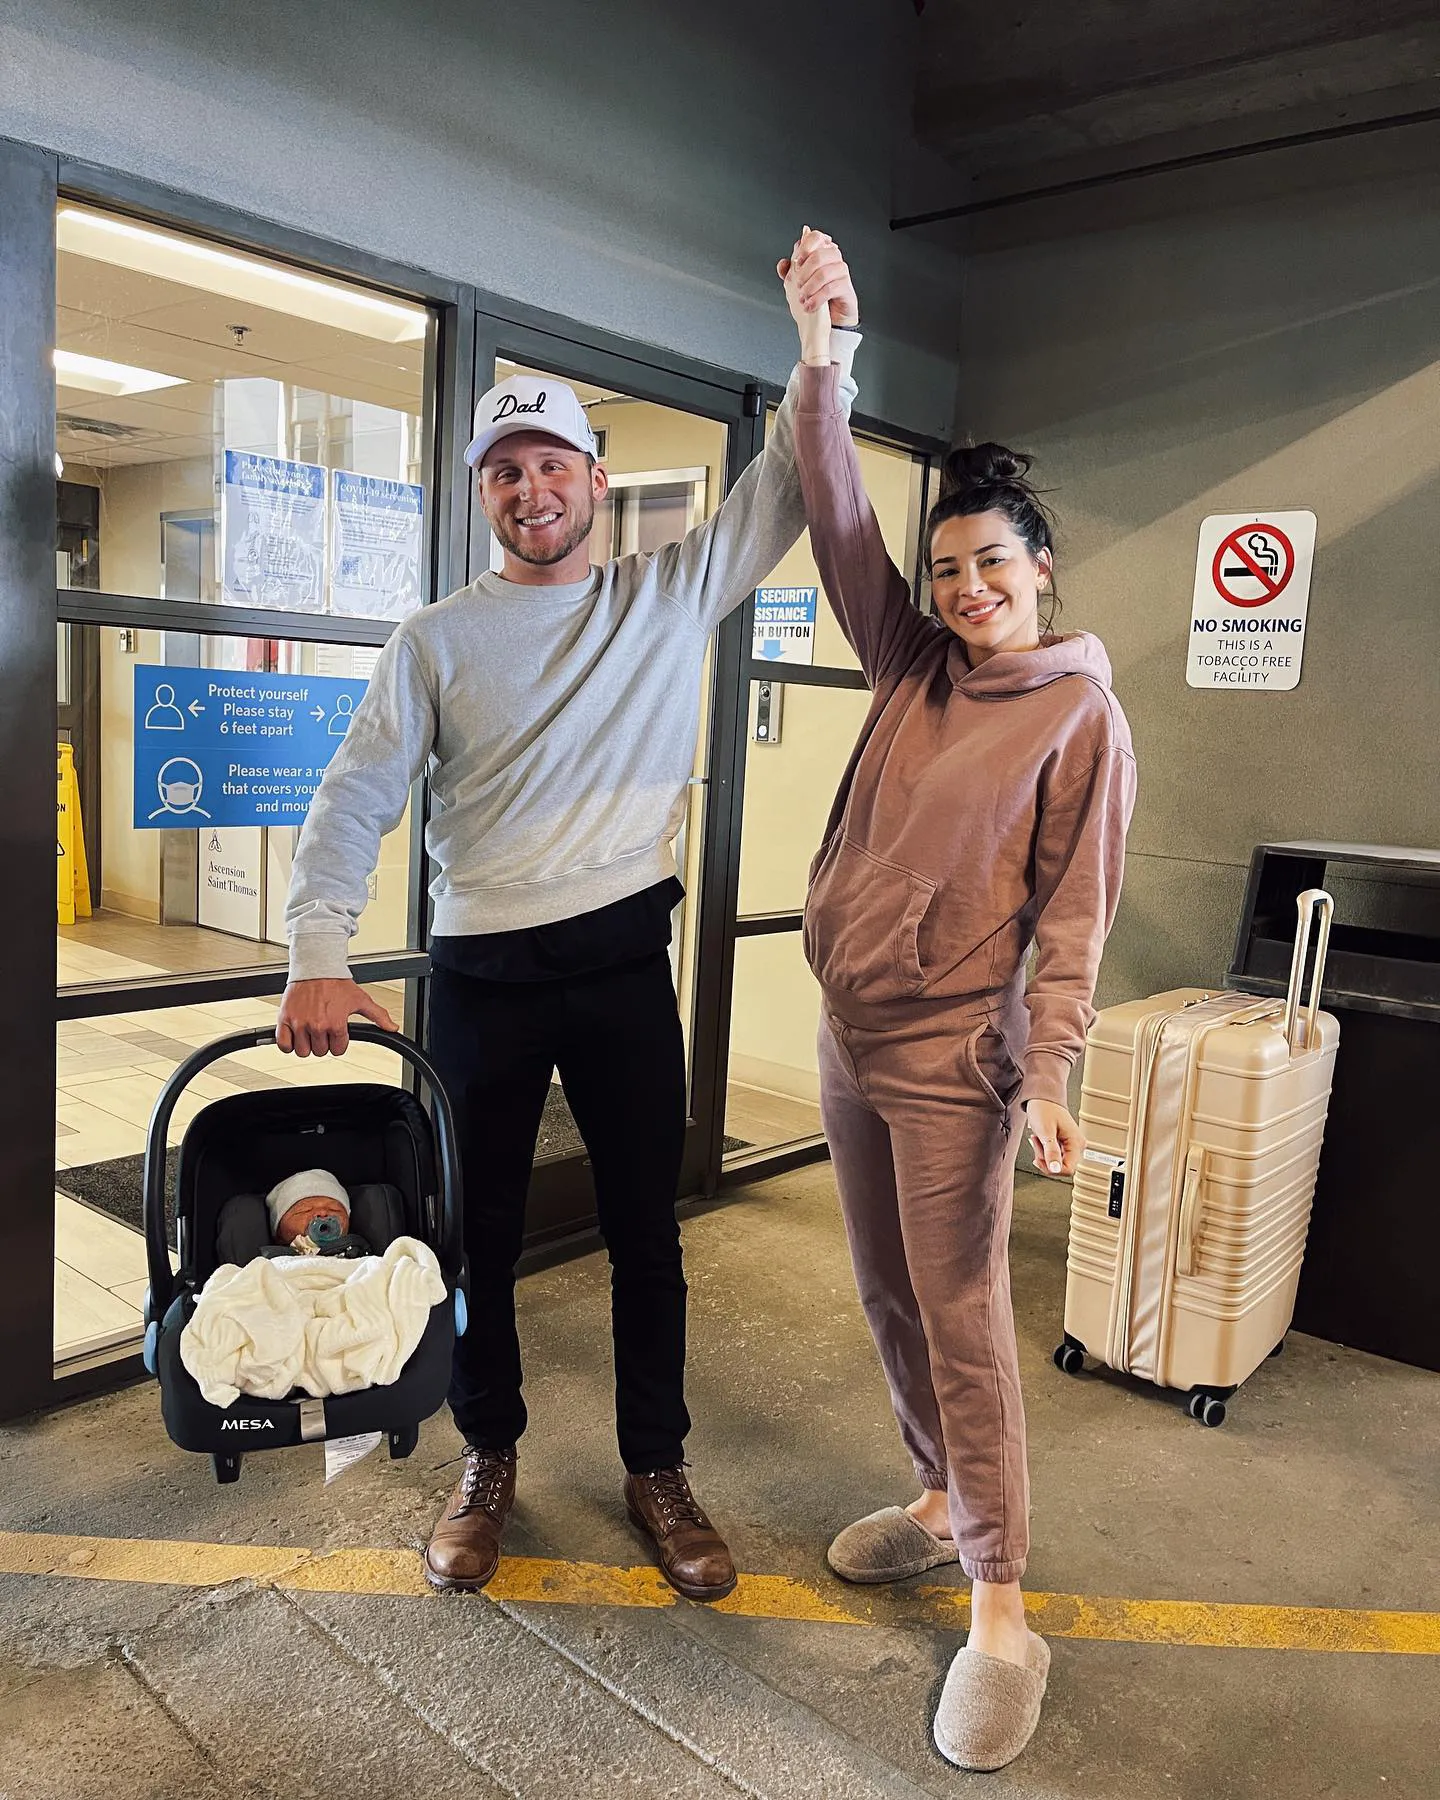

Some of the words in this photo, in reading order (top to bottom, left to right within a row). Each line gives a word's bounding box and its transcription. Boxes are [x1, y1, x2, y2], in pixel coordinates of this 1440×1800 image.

[492, 392, 546, 422] Dad
[340, 484, 380, 497] COVID-19
[760, 589, 814, 603] SECURITY
[768, 626, 810, 638] BUTTON
[1193, 619, 1217, 632] NO
[1221, 619, 1302, 633] SMOKING
[1218, 640, 1246, 650] THIS
[1249, 640, 1260, 650] IS
[1264, 640, 1273, 650] A
[1197, 655, 1258, 667] TOBACCO
[1262, 656, 1292, 667] FREE
[1213, 671, 1270, 683] FACILITY
[208, 683, 255, 698] Protect
[259, 688, 308, 701] yourself
[223, 703, 265, 717] Please
[268, 707, 294, 720] stay
[219, 721, 228, 734] 6
[232, 721, 257, 735] feet
[260, 724, 293, 738] apart
[228, 764, 270, 777] Please
[273, 767, 302, 777] wear
[305, 767, 312, 777] a
[222, 781, 248, 794] that
[251, 785, 291, 795] covers
[256, 799, 278, 812] and
[208, 861, 246, 879] Ascension
[207, 876, 227, 890] Saint
[227, 880, 258, 897] Thomas
[221, 1419, 275, 1430] MESA
